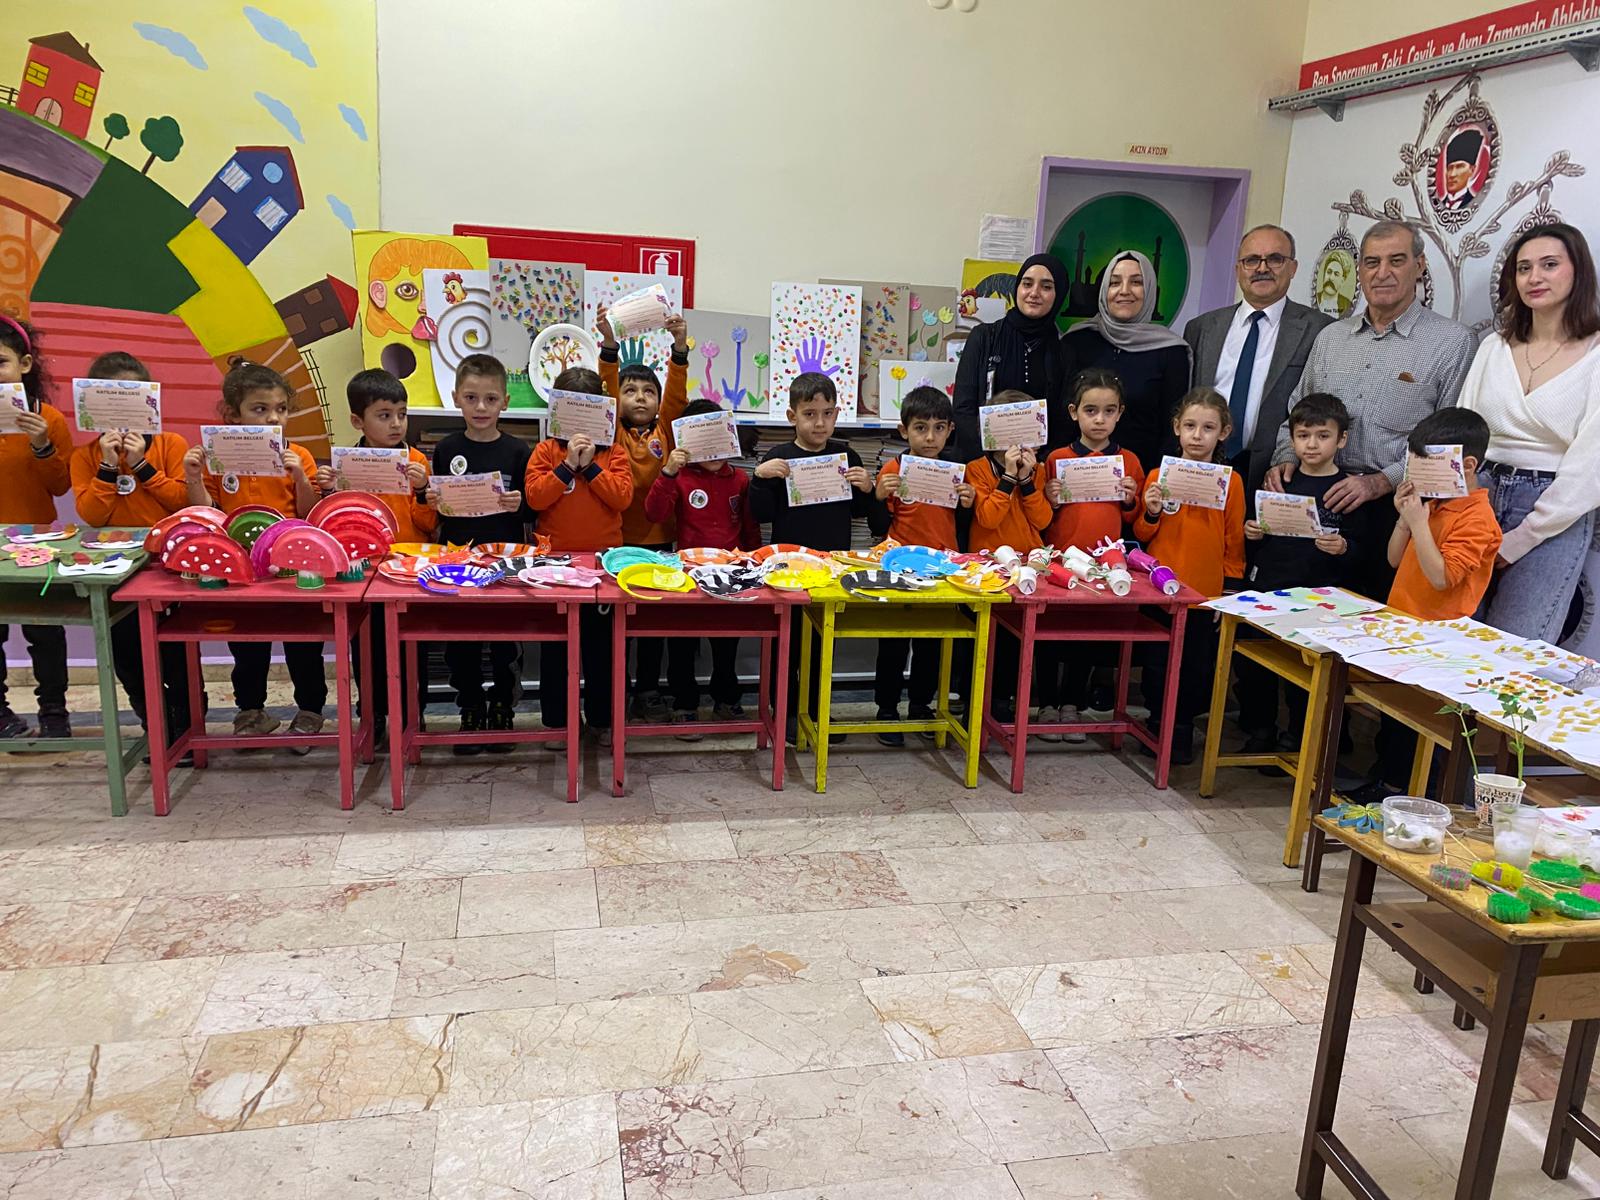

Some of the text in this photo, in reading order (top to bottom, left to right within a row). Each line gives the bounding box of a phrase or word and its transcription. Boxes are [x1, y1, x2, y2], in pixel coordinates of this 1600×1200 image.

[1312, 71, 1329, 88] Ben
[1381, 48, 1403, 70] Zeki
[1441, 42, 1454, 55] ve
[1487, 11, 1547, 44] Zamanda
